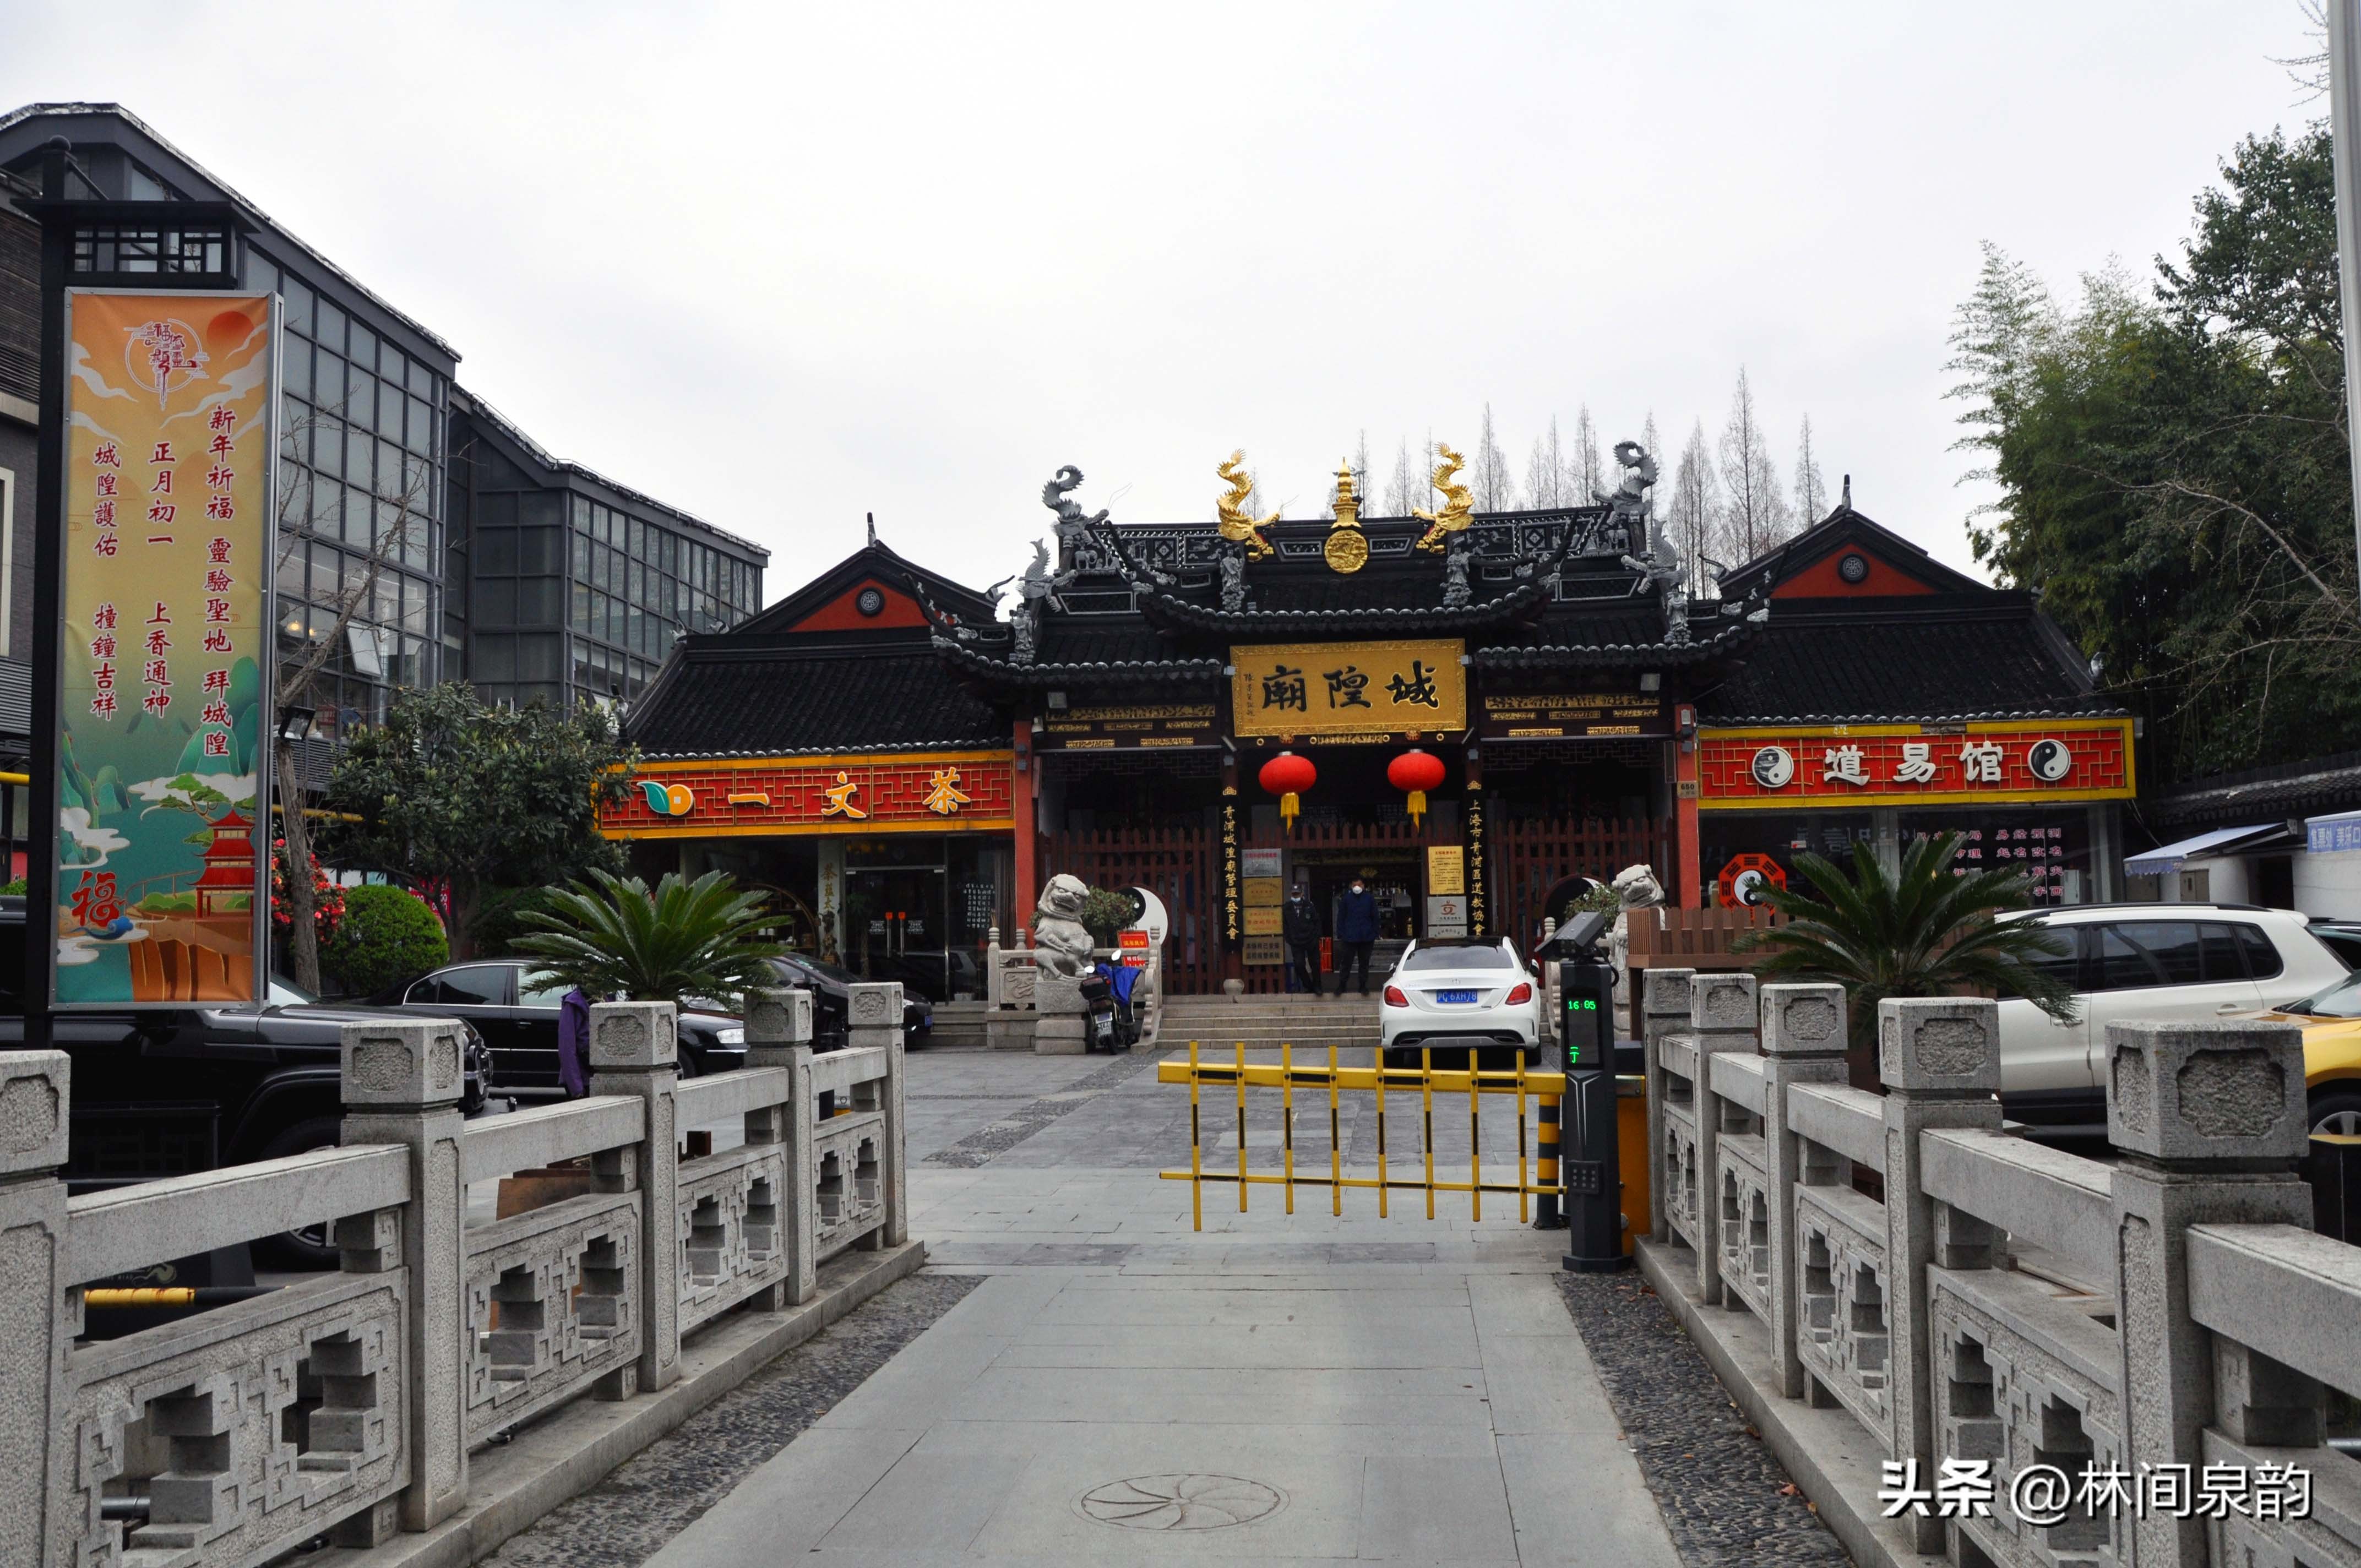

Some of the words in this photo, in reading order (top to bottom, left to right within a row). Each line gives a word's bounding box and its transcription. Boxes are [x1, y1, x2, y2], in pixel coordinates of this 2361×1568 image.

[93, 442, 121, 557] 城隍護佑
[147, 442, 176, 544] 正月初一
[206, 405, 236, 520] 新年祈福
[203, 537, 234, 653] 靈驗聖地
[90, 604, 118, 720] 撞鐘吉祥
[143, 602, 172, 718] 上香通神
[202, 671, 232, 757] 拜城隍
[1823, 741, 2004, 786] 道易馆
[728, 766, 971, 819] 一文茶
[1995, 827, 2061, 841] 易经预测
[70, 870, 127, 927] 福
[1468, 799, 1485, 937] 上海市青浦區道教協會
[1996, 846, 2063, 858] 起名改名
